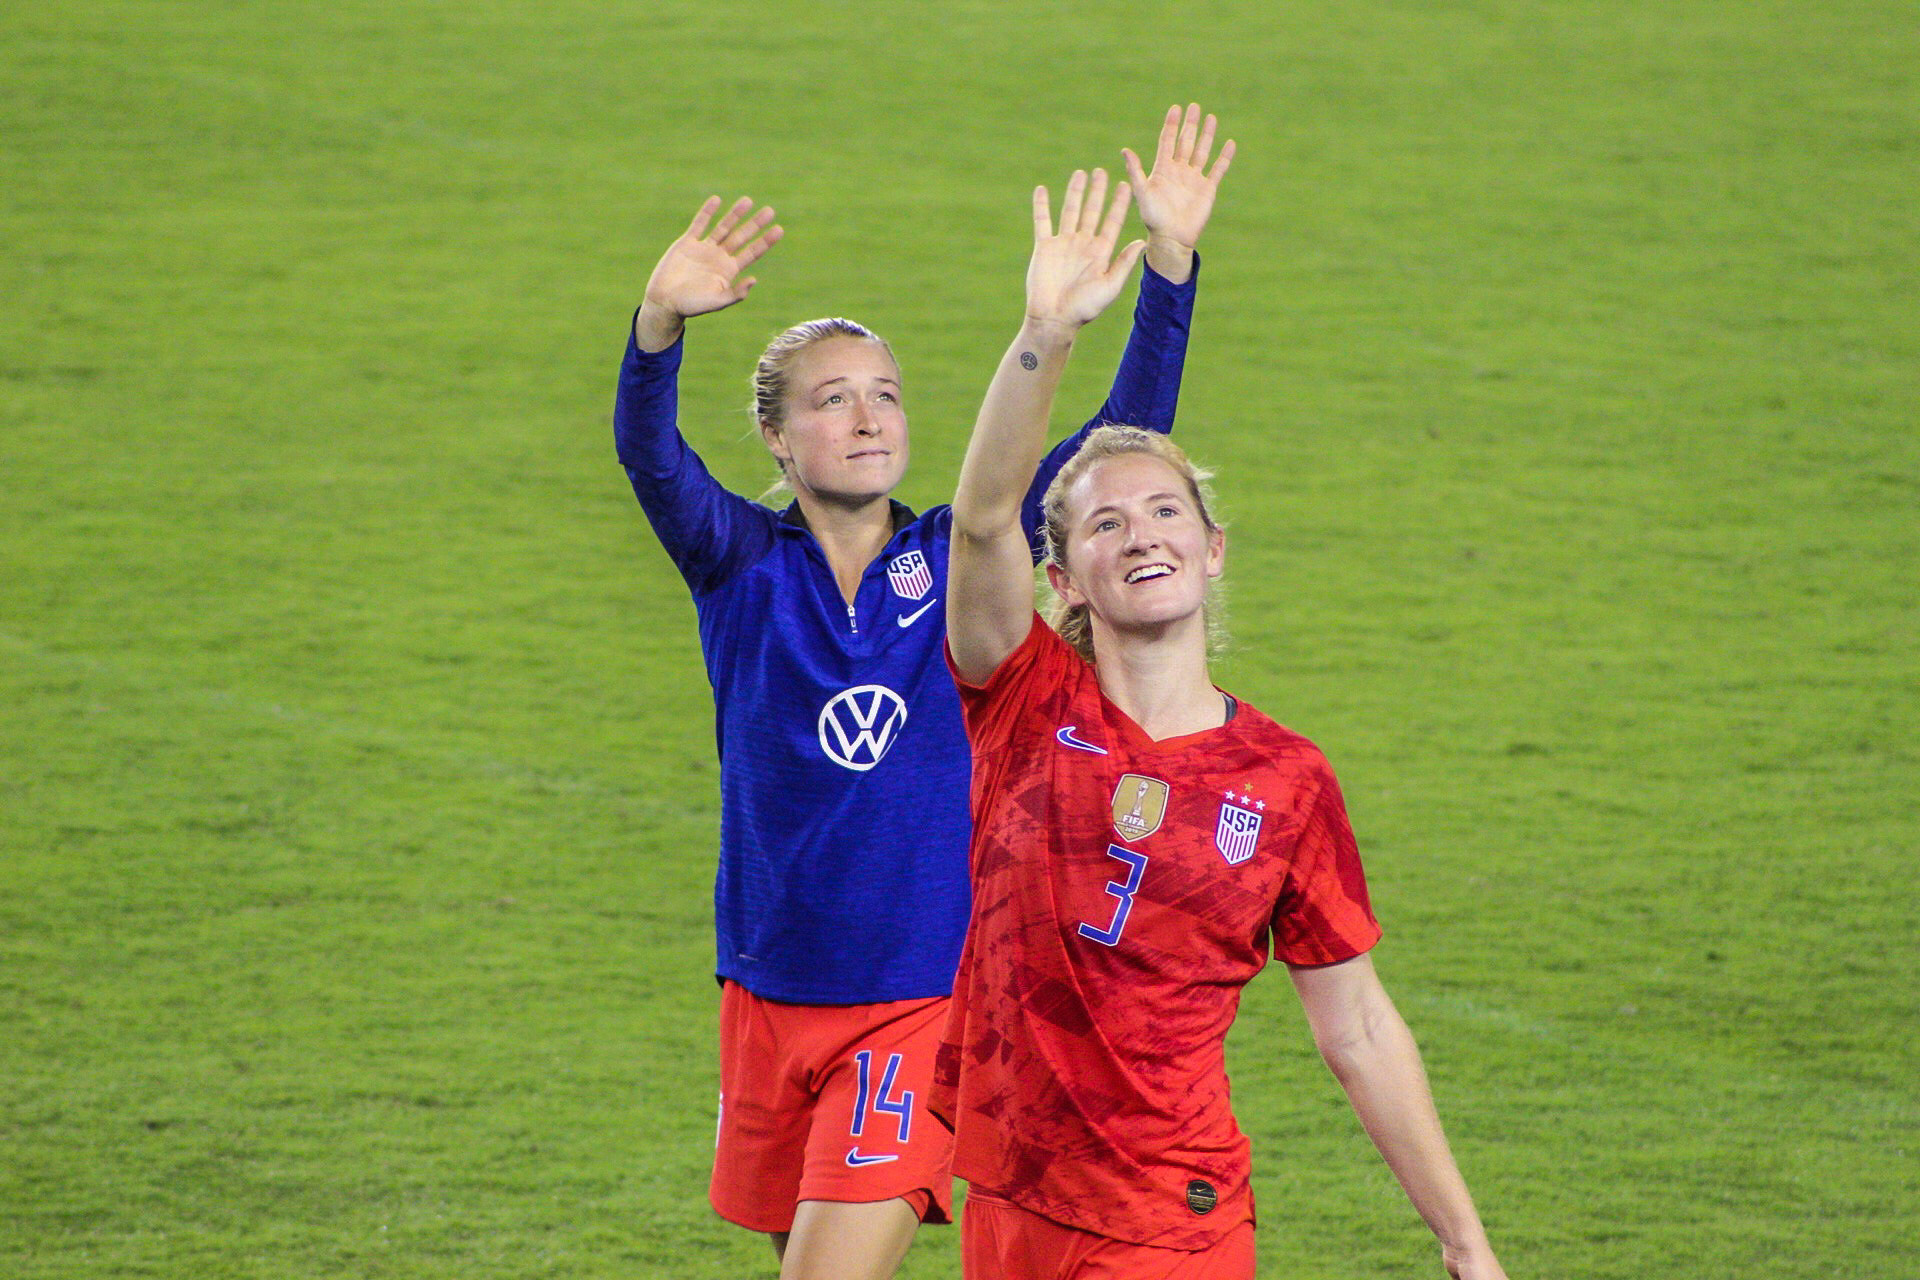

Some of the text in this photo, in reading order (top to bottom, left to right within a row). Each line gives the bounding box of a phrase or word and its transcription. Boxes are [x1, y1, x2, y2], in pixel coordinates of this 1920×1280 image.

[888, 552, 923, 575] USA
[825, 688, 904, 763] VW
[1122, 814, 1145, 828] FIFA
[1223, 806, 1259, 834] USA
[1078, 843, 1149, 947] 3
[850, 1049, 914, 1143] 14
